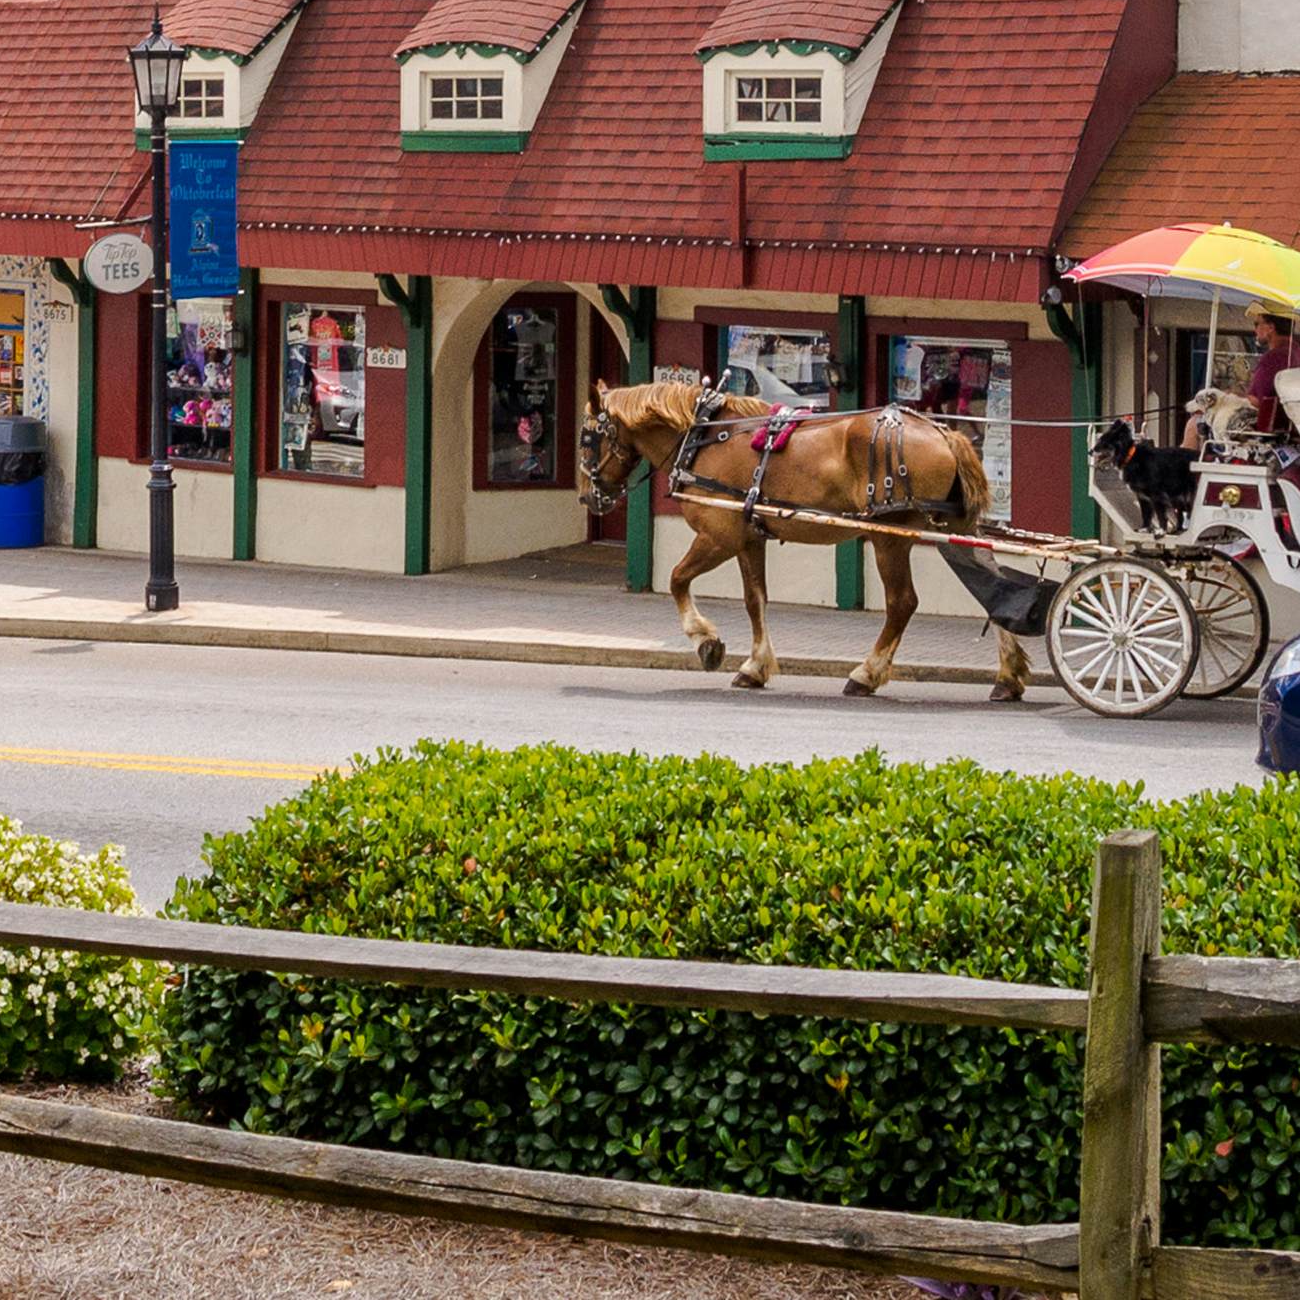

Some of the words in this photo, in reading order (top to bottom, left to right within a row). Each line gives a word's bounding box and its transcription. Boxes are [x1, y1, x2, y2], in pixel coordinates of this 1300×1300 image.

[179, 154, 227, 171] Welcome
[195, 169, 212, 185] To
[171, 184, 235, 200] Oktoberfest
[103, 243, 120, 263] Tip
[120, 242, 138, 261] Top
[102, 262, 140, 280] TEES
[43, 308, 66, 320] 8675
[371, 353, 400, 365] 8681
[660, 372, 693, 386] 8685
